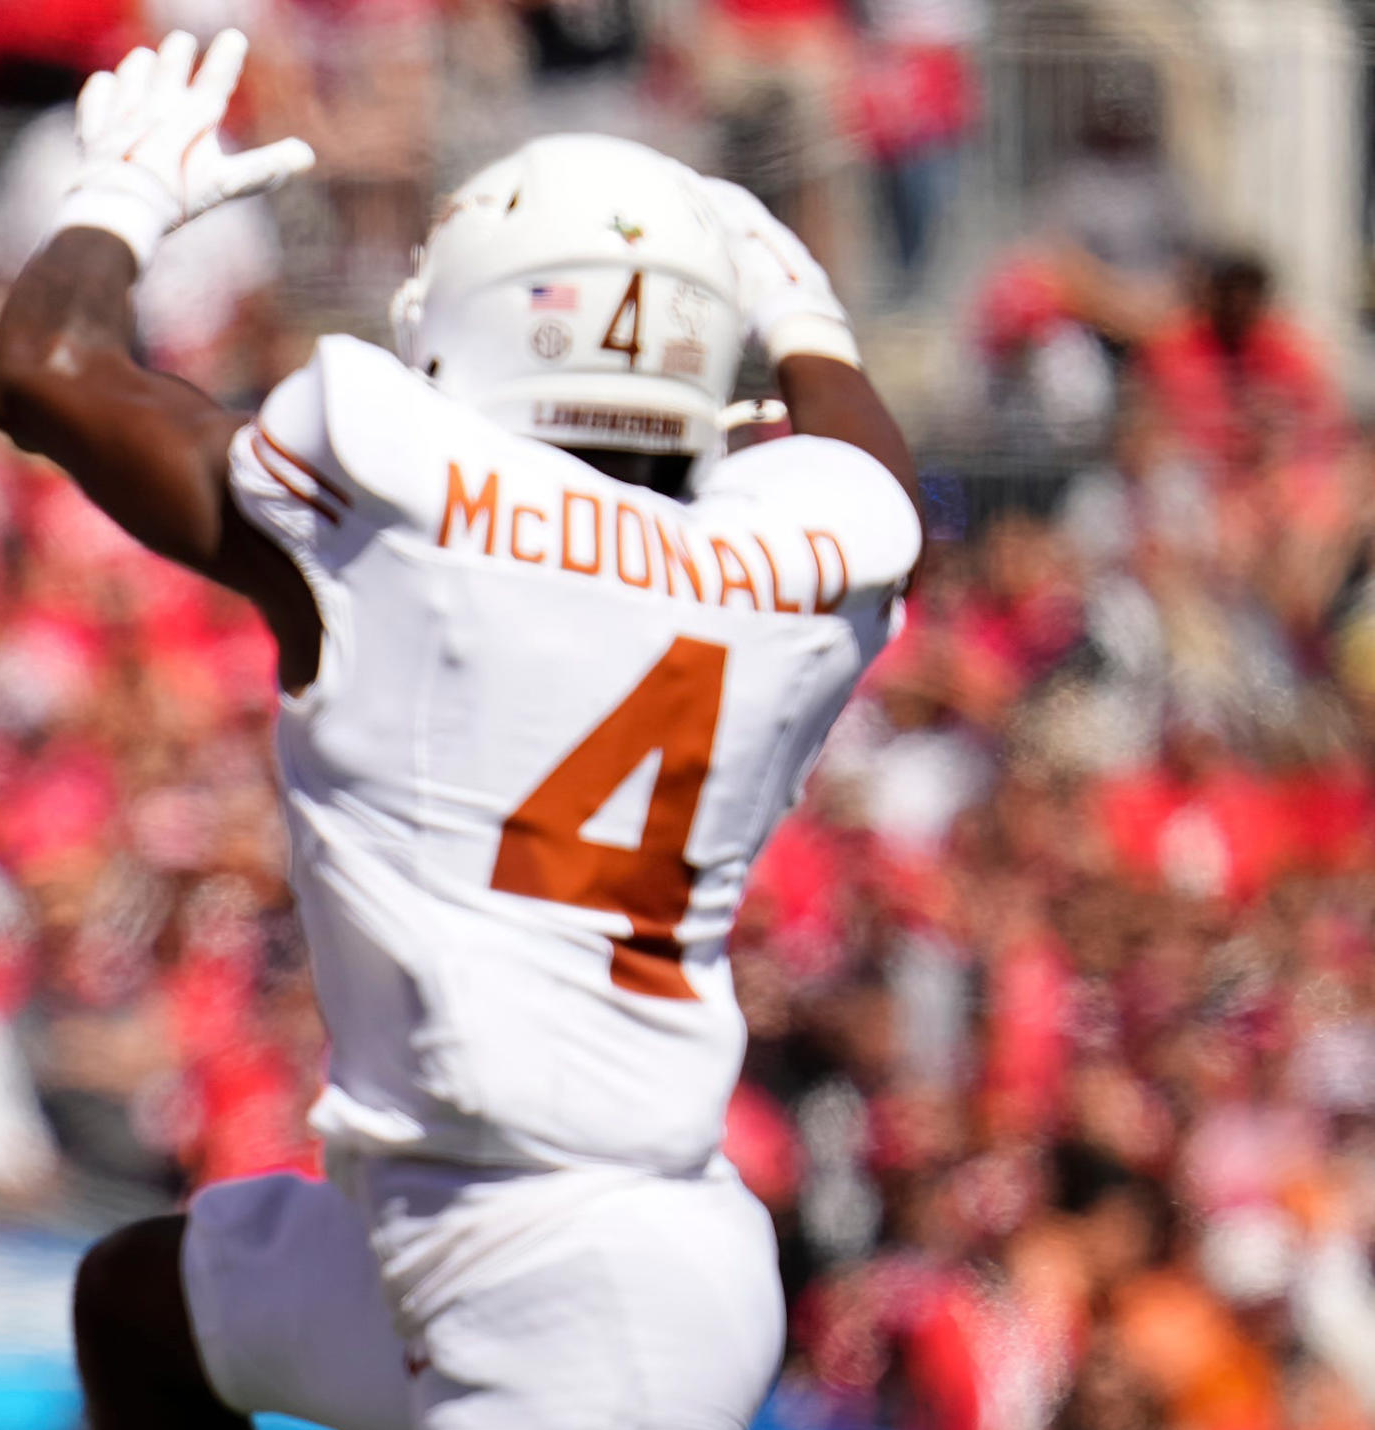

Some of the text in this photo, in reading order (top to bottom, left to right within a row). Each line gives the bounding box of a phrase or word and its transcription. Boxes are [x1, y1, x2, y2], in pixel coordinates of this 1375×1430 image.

[600, 270, 644, 373] 4
[438, 460, 848, 616] McDONALD
[491, 635, 730, 1001] 4
